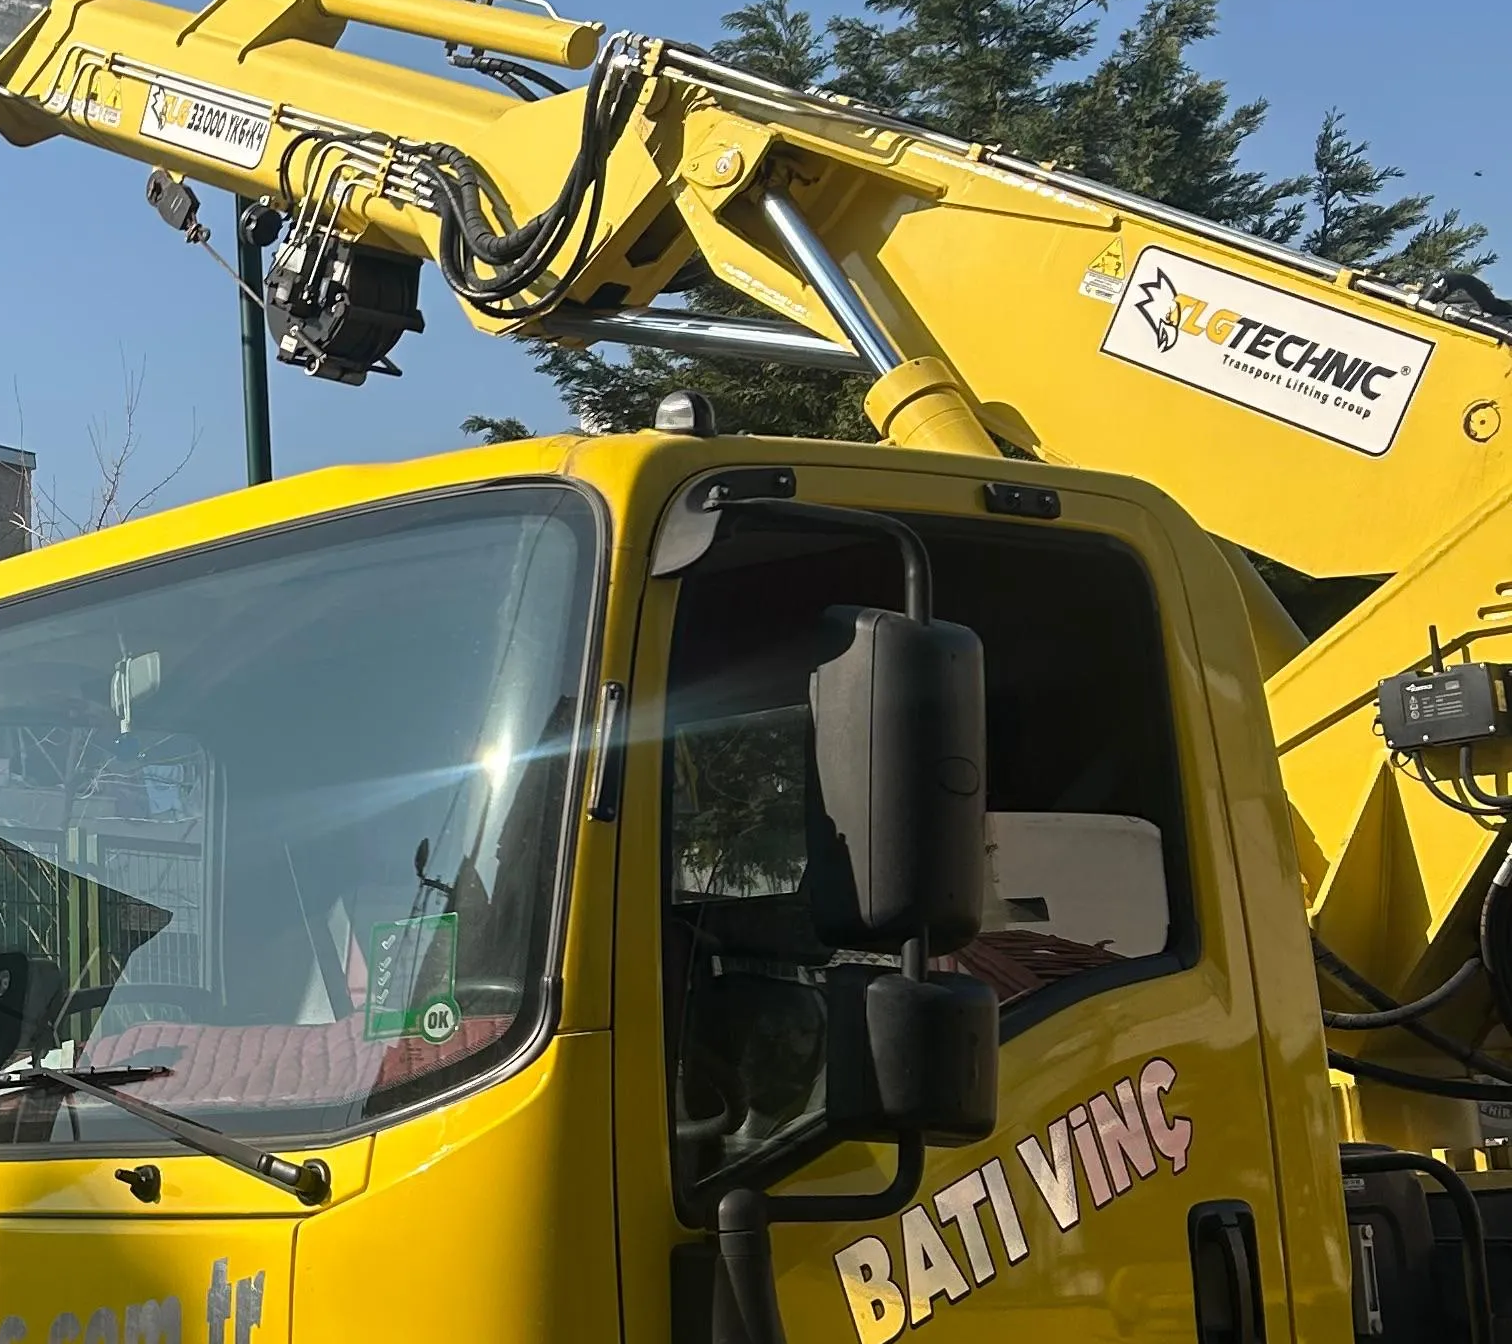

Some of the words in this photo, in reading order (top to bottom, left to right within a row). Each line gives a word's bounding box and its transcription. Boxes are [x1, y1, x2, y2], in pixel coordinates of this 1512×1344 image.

[1222, 354, 1282, 384] Transport
[1285, 377, 1329, 404] Lifting
[1333, 396, 1371, 420] Group
[428, 1011, 449, 1030] OK
